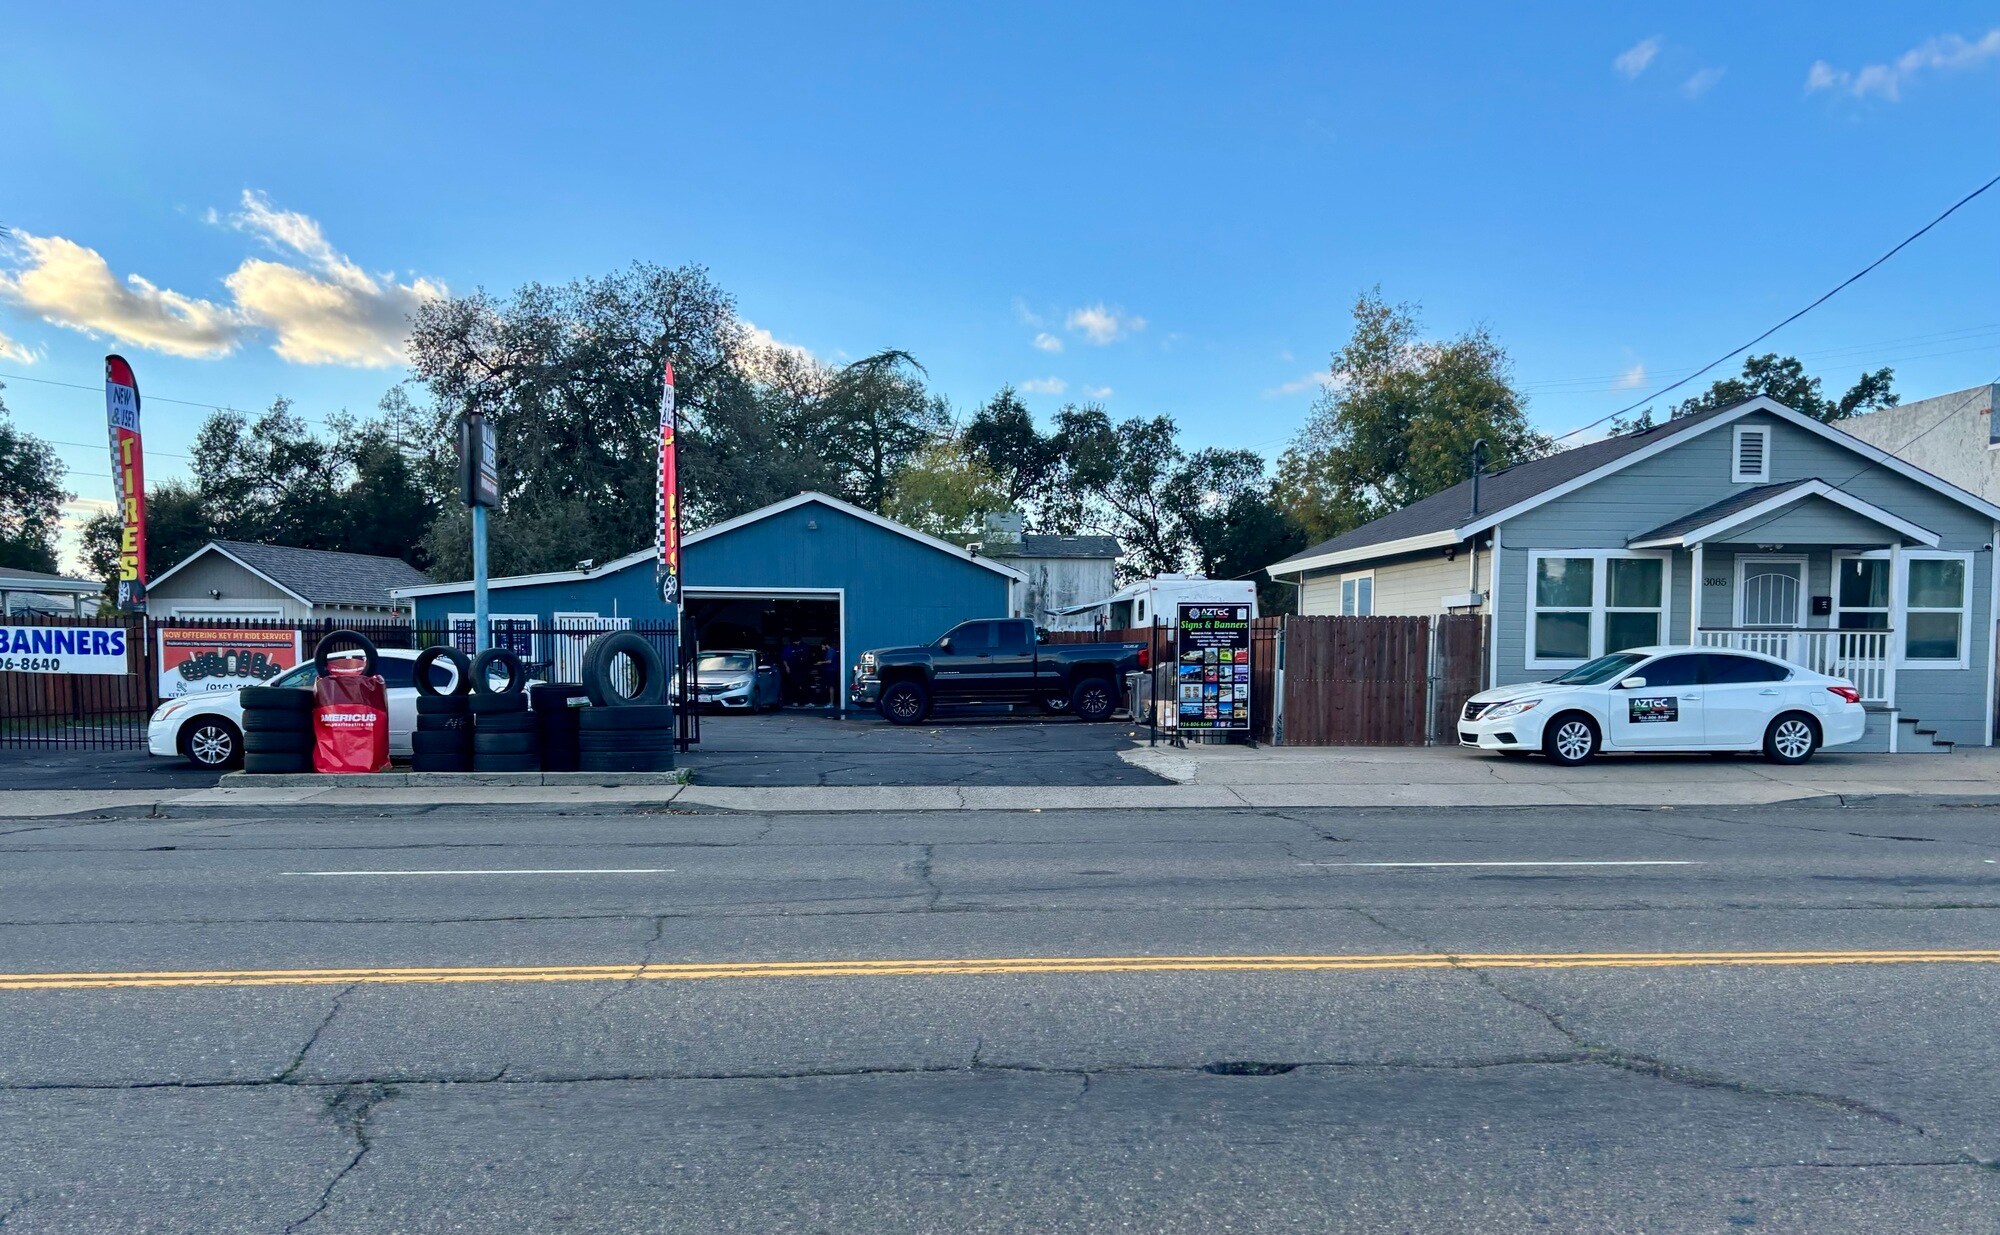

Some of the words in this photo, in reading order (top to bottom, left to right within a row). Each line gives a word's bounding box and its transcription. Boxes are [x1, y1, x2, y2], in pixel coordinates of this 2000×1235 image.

[113, 386, 131, 406] NEW
[111, 407, 120, 425] &
[120, 437, 138, 581] TIRES
[1703, 577, 1727, 587] 3085
[1180, 620, 1203, 631] Signs
[1204, 620, 1212, 629] &
[1214, 620, 1249, 629] Banners
[0, 629, 125, 656] BANNERS
[182, 631, 217, 639] OFFERING
[244, 632, 260, 640] RIDE
[261, 632, 292, 640] SERVICE!
